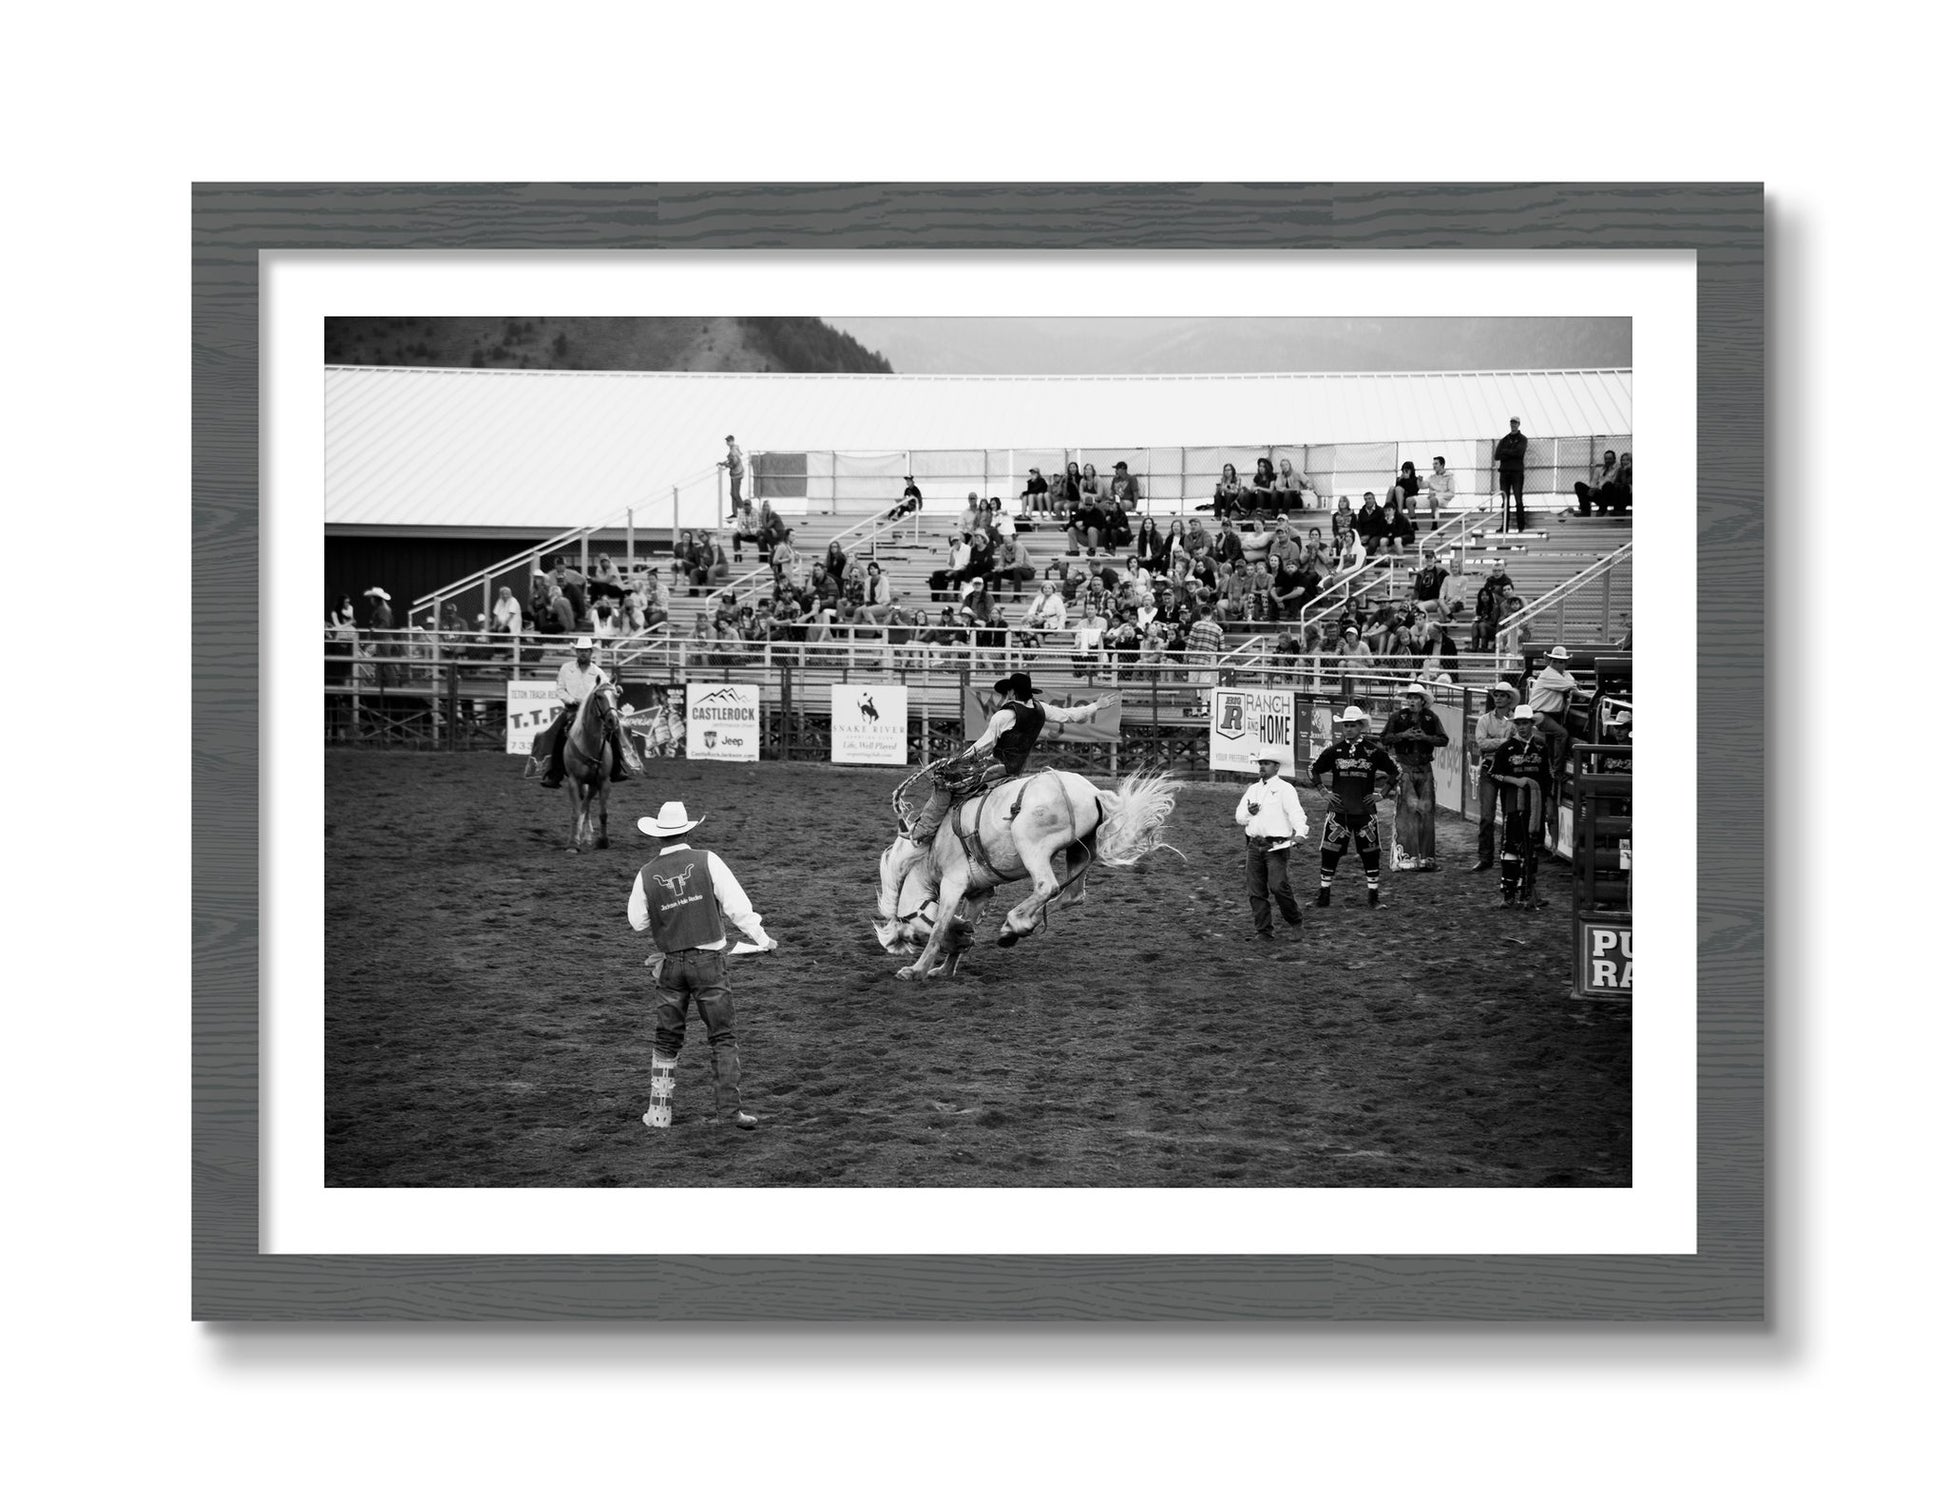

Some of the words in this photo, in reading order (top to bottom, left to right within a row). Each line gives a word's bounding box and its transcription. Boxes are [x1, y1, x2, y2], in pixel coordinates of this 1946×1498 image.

[1246, 694, 1290, 715] RANCH
[692, 707, 755, 721] CASTLEROCK
[1220, 705, 1243, 730] R
[832, 725, 866, 733] SNAKE
[873, 725, 905, 734] RIVER
[1260, 714, 1291, 746] HOME
[721, 736, 744, 747] Jeep
